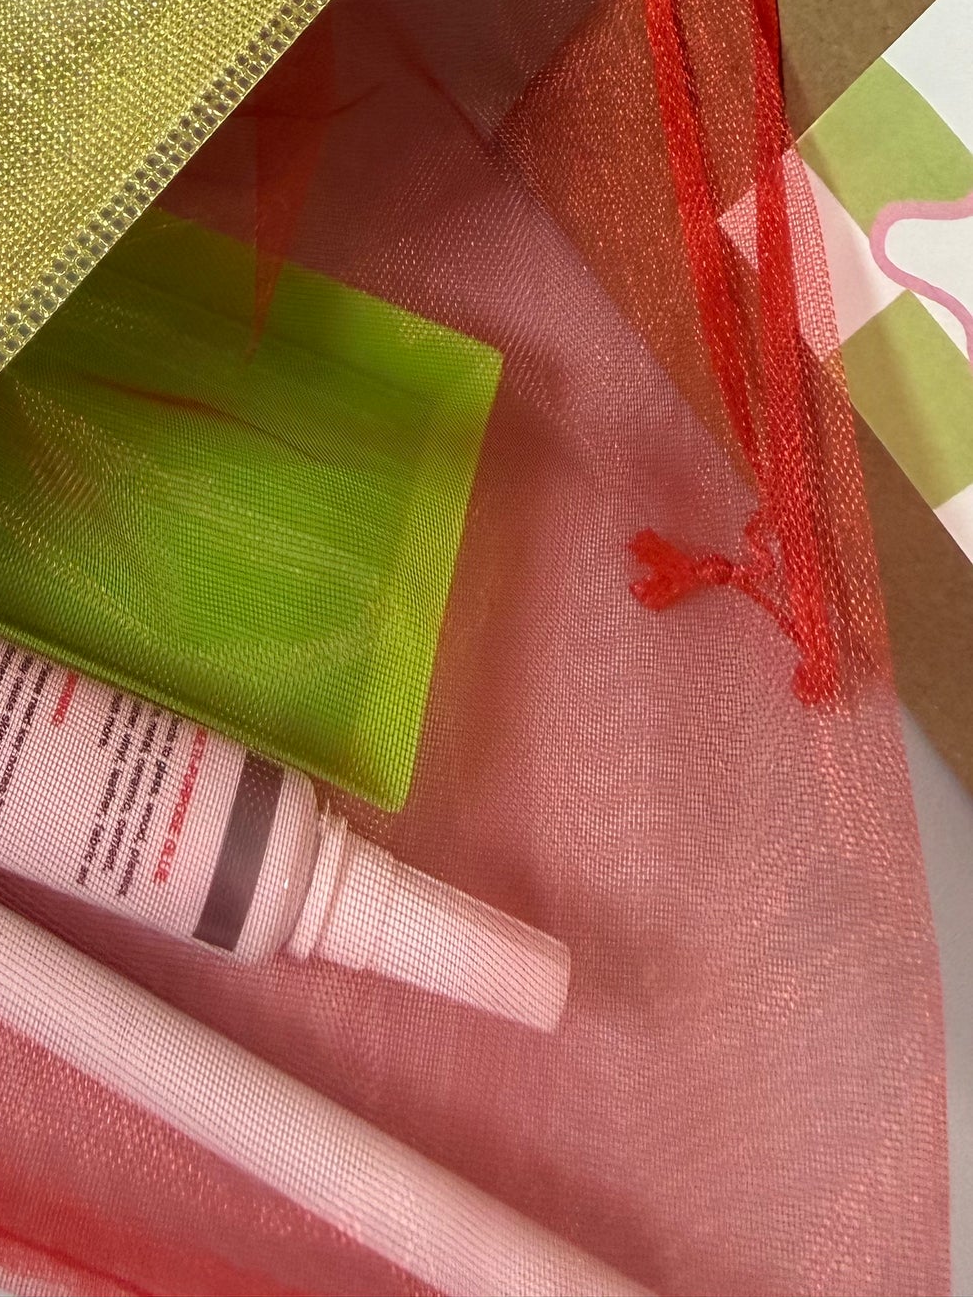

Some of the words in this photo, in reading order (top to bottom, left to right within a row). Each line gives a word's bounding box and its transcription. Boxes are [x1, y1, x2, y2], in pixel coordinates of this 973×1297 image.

[3, 675, 26, 713] cause
[21, 696, 40, 727] read
[10, 726, 29, 753] key
[95, 714, 116, 750] more.
[95, 766, 123, 822] leather,
[118, 755, 148, 816] ceramic,
[146, 758, 168, 799] glass,
[82, 822, 105, 864] fabric
[131, 799, 156, 846] wood,
[75, 864, 91, 886] and
[153, 837, 177, 885] GLUE
